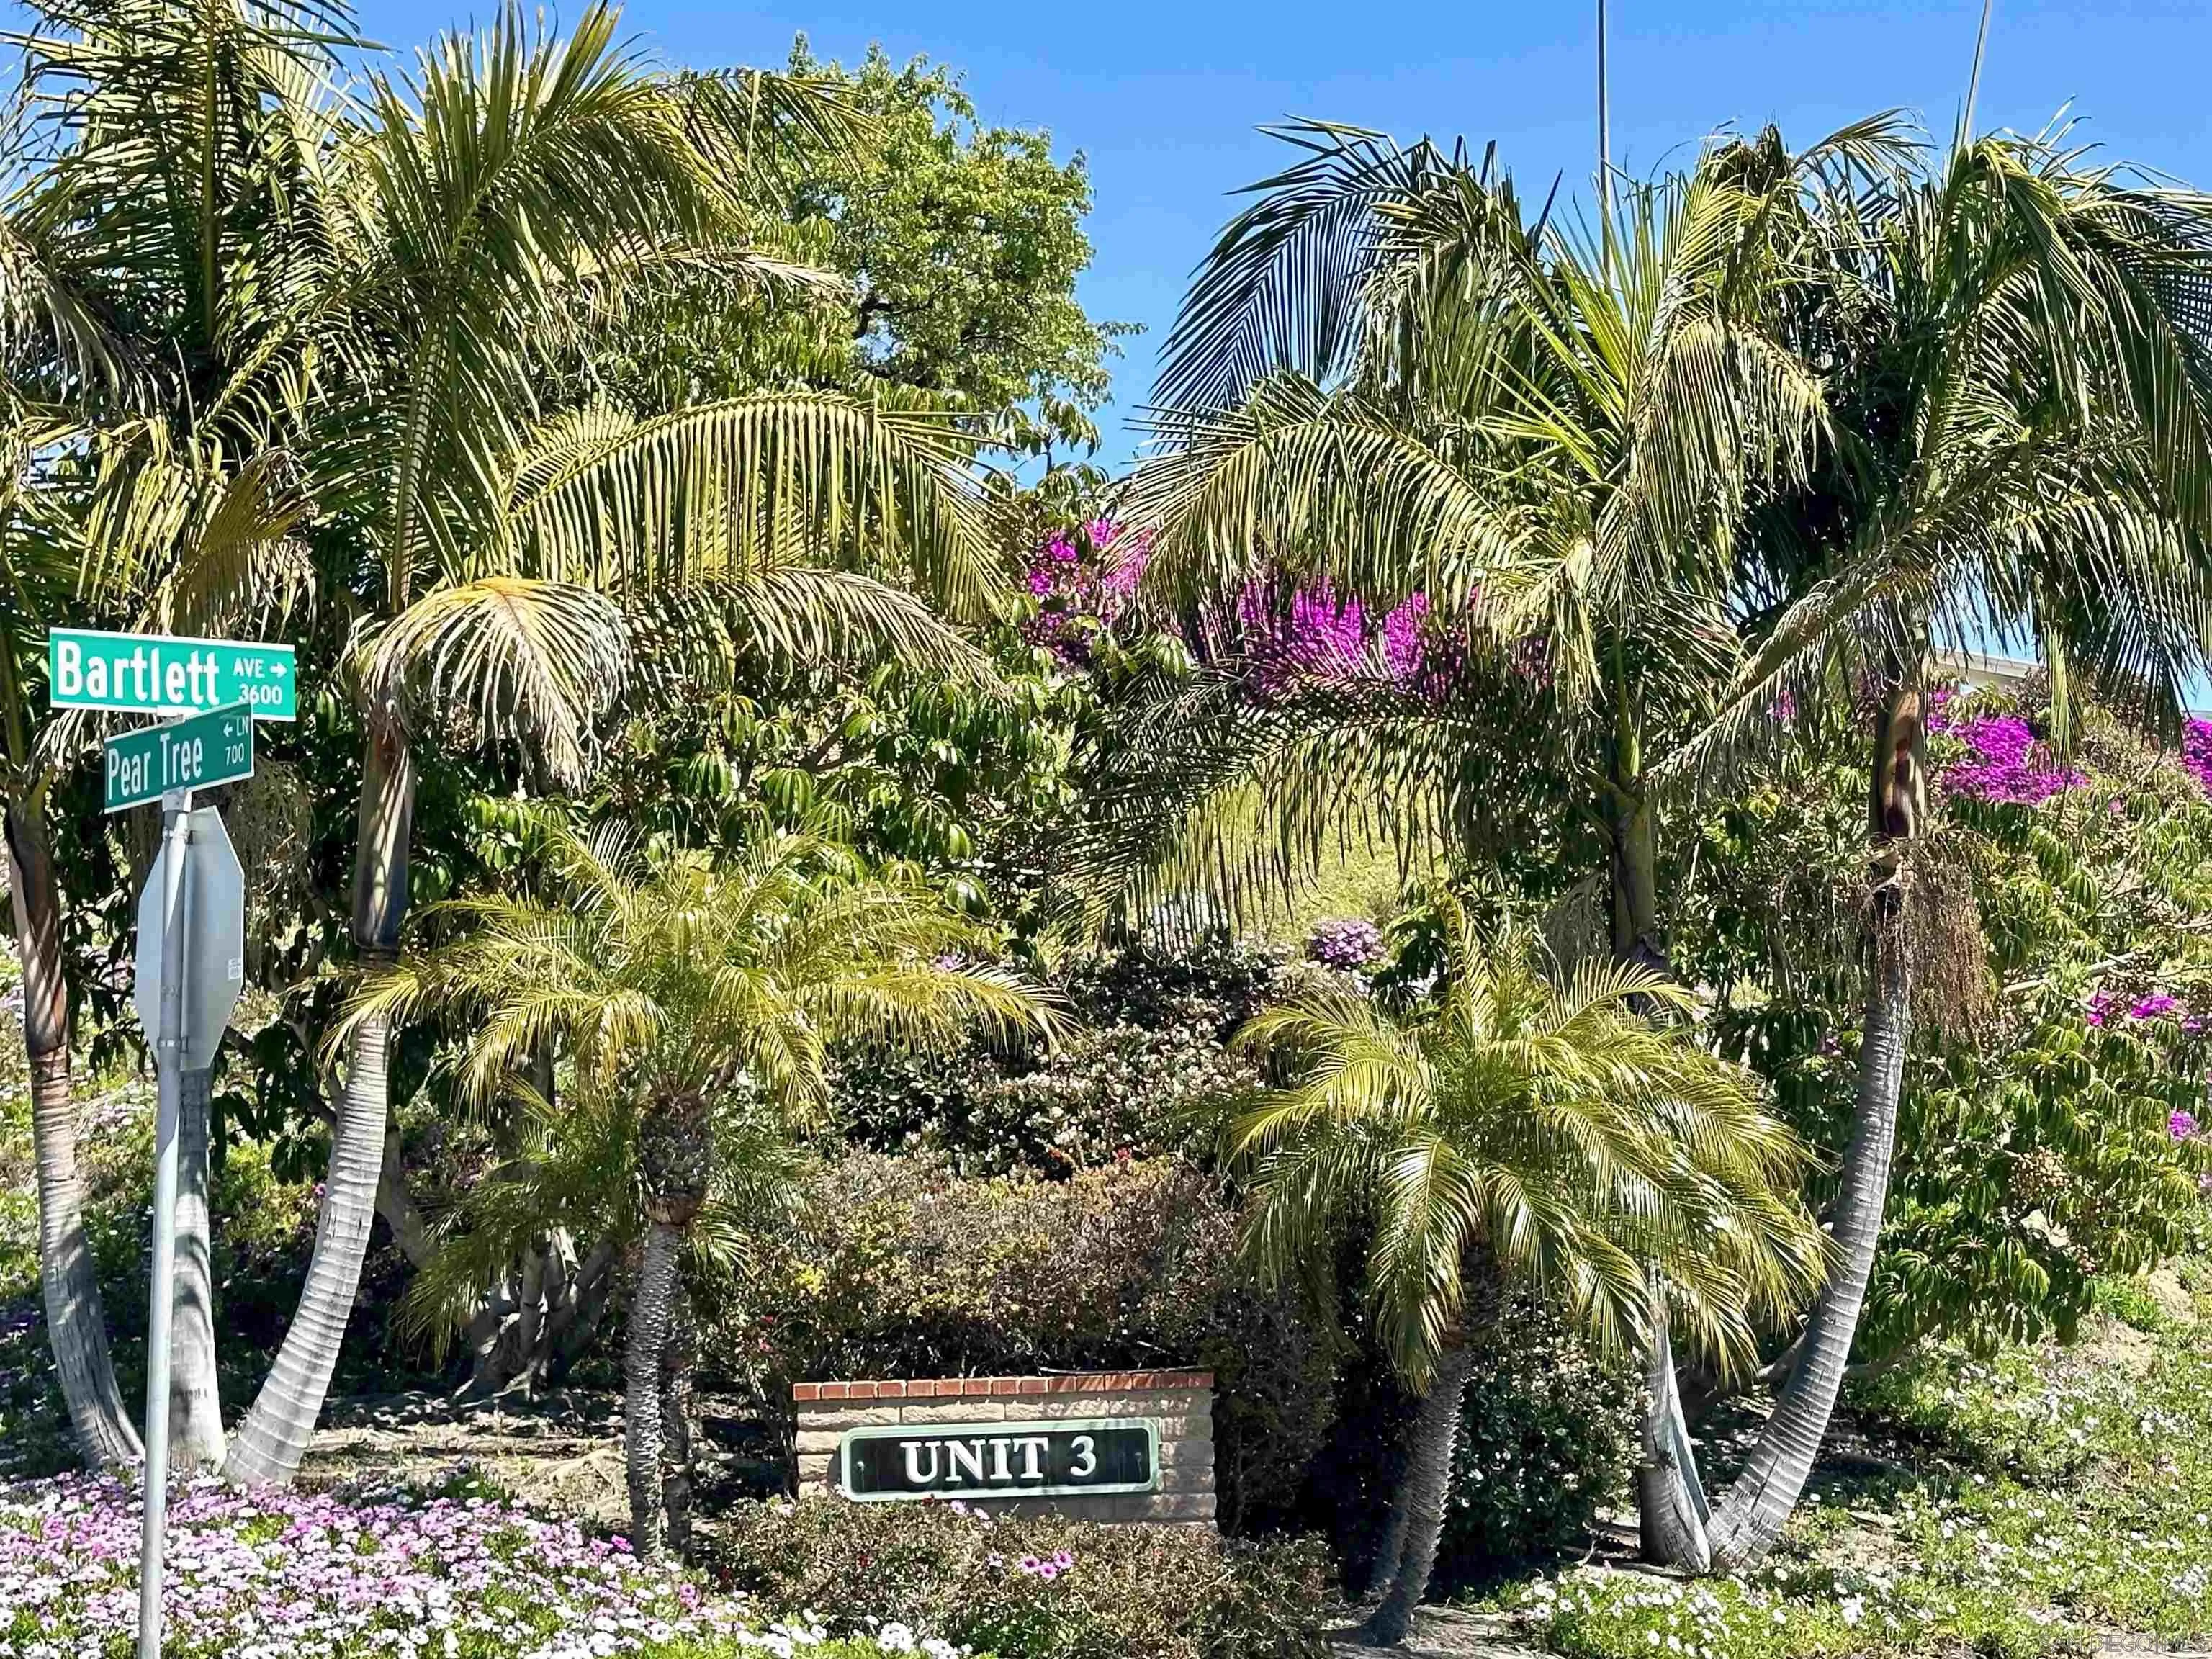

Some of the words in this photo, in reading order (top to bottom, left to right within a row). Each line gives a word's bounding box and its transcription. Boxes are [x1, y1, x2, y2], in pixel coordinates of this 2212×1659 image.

[57, 639, 220, 705] Bartlett
[232, 657, 266, 678] AVE
[238, 683, 283, 705] 3600
[108, 747, 152, 801] Pear
[159, 732, 204, 786] Tree
[235, 715, 249, 737] LN
[225, 742, 246, 767] 700
[900, 1437, 1049, 1483] UNIT
[1069, 1435, 1098, 1478] 3
